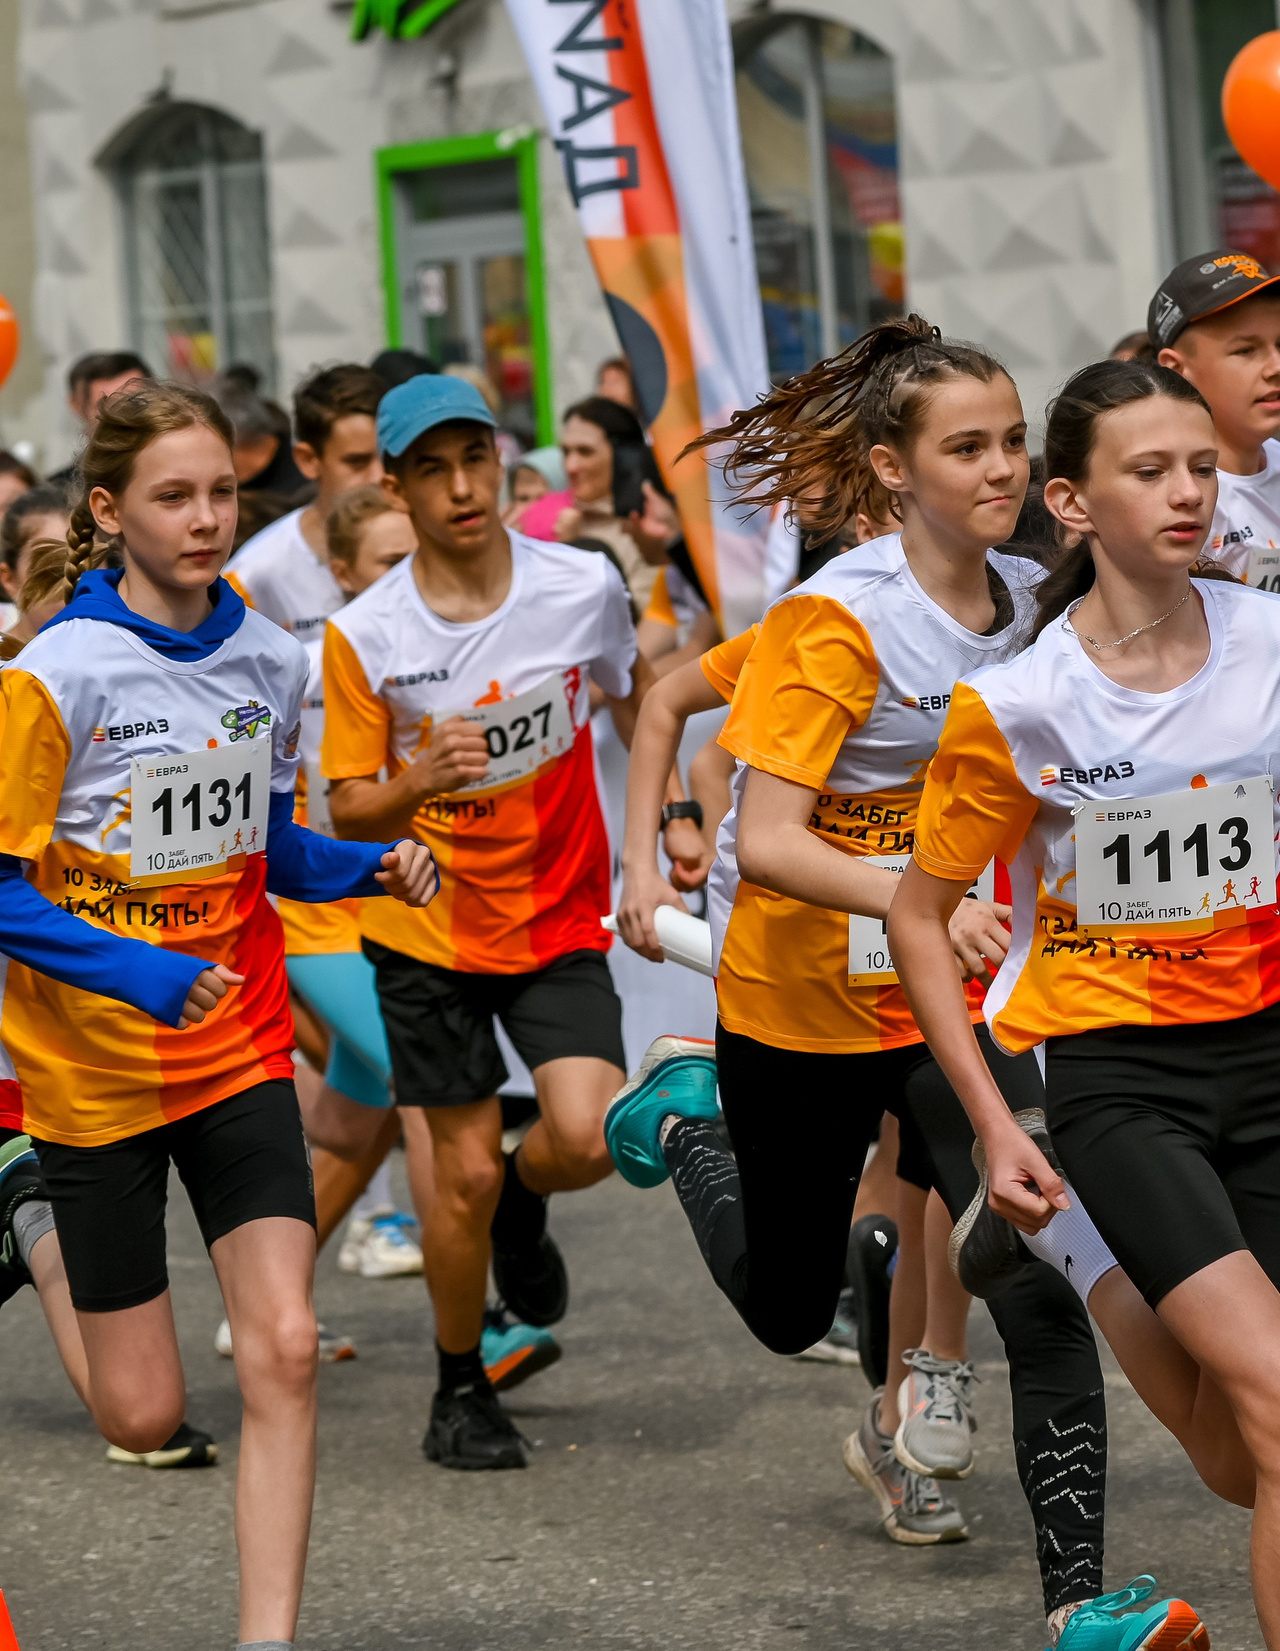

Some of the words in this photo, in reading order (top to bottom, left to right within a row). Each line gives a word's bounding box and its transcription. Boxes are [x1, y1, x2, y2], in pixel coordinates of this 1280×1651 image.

[395, 669, 449, 687] ЕВРАЗ
[919, 694, 951, 710] ЕВР
[108, 718, 170, 741] ЕВРАЗ
[484, 701, 553, 760] 027
[155, 764, 189, 778] ЕВРАЗ
[1060, 761, 1135, 785] ЕВРАЗ
[152, 772, 252, 836] 1131
[1107, 809, 1152, 821] ЕВРАЗ
[1103, 816, 1252, 885] 1113
[147, 852, 165, 871] 10
[167, 853, 189, 870] ДАЙ
[191, 852, 214, 865] ПЯТЬ
[62, 867, 84, 887] 10
[126, 901, 209, 928] ПЯТЬ!
[1098, 902, 1122, 920] 10
[1125, 906, 1154, 922] ДАЙ
[1158, 905, 1192, 919] ПЯТЬ
[1126, 901, 1150, 909] ЗАБЕГ
[866, 951, 885, 969] 10
